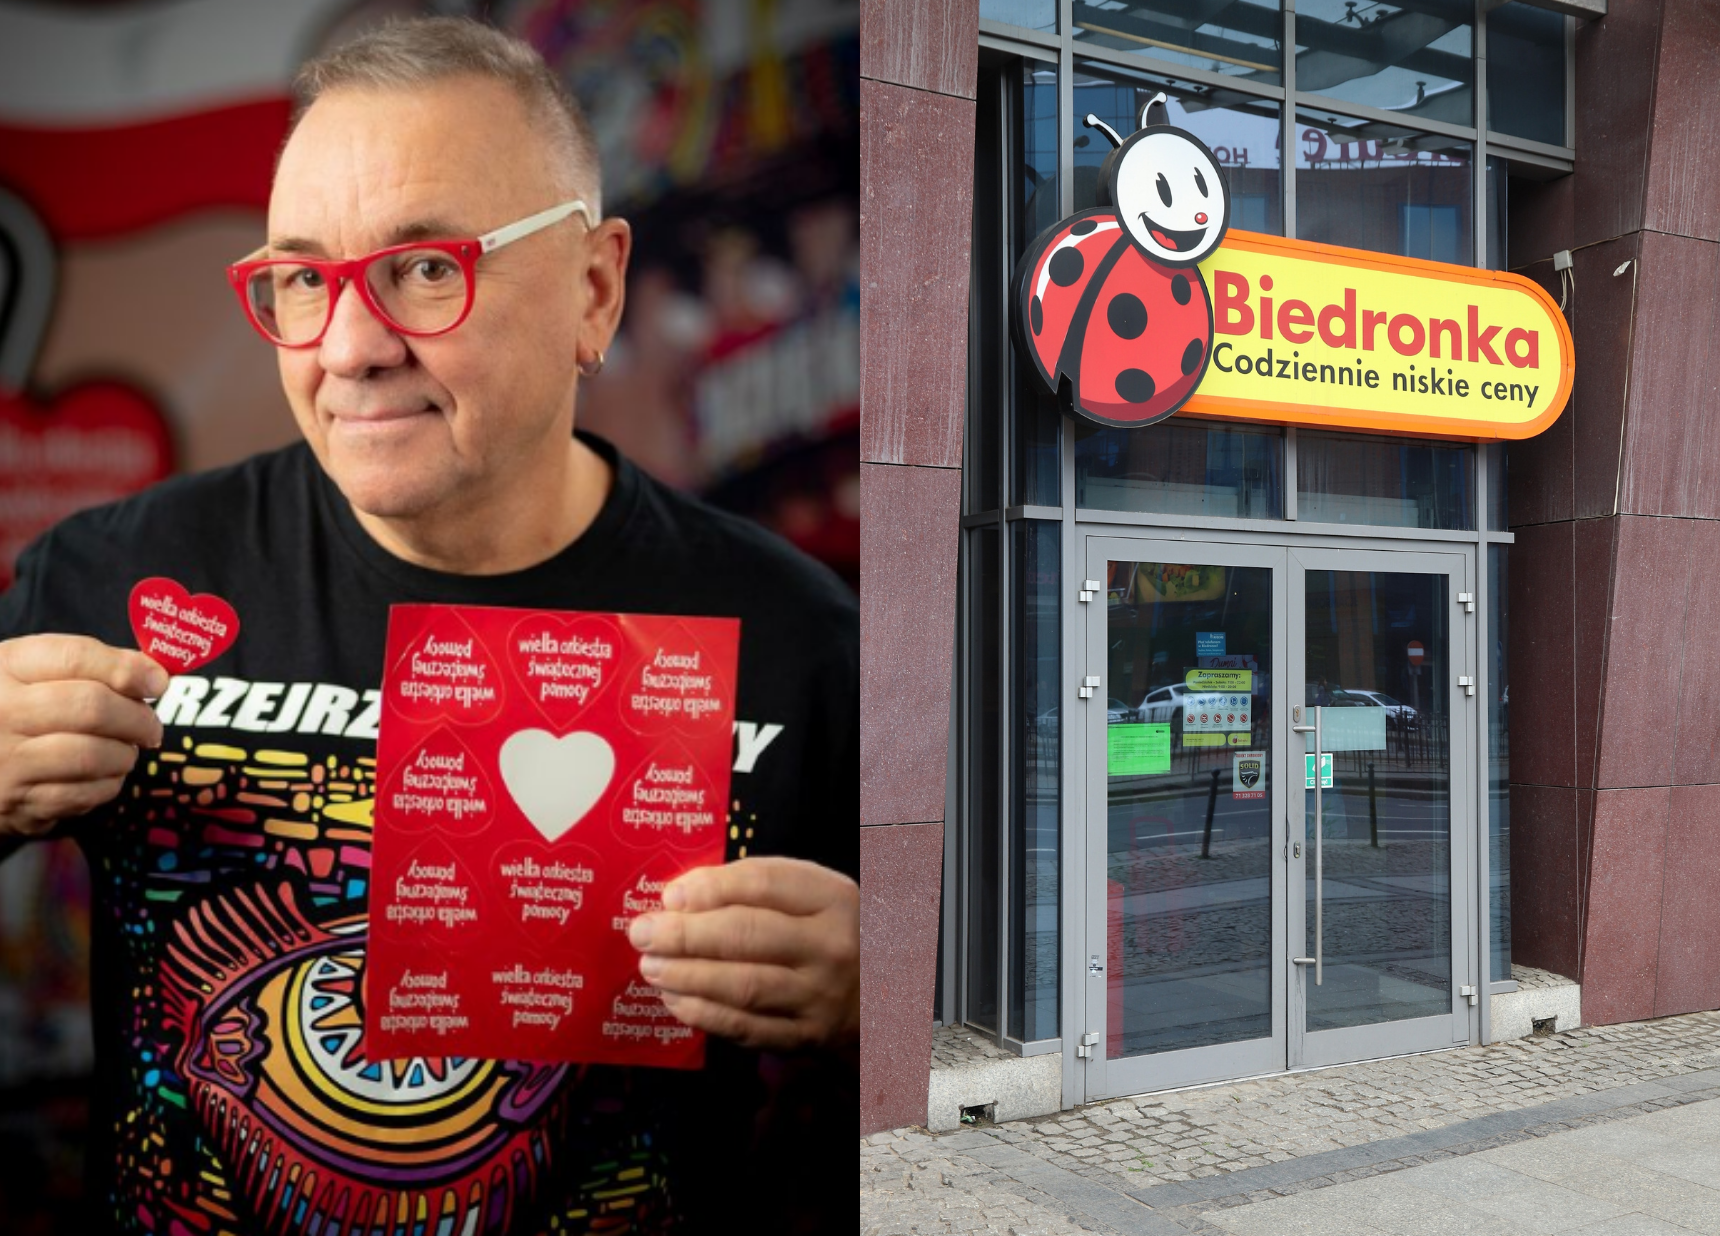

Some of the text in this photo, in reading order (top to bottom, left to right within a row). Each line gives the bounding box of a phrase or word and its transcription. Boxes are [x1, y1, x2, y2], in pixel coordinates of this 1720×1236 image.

[1214, 270, 1539, 369] Biedronka
[1213, 342, 1539, 408] Codziennie niskie ceny
[149, 637, 197, 667] pomocy
[423, 635, 474, 659] pomocy
[518, 631, 612, 659] wielka orkiestra
[653, 648, 700, 670] pomocy
[1198, 671, 1241, 679] Zapraszamy:
[540, 682, 590, 705] pomocy
[144, 675, 382, 739] RZEJRZ
[415, 749, 465, 772] pomocy
[644, 763, 693, 784] pomocy
[407, 859, 456, 881] pomocy
[521, 903, 571, 925] pomocy
[512, 1010, 561, 1031] pomocy
